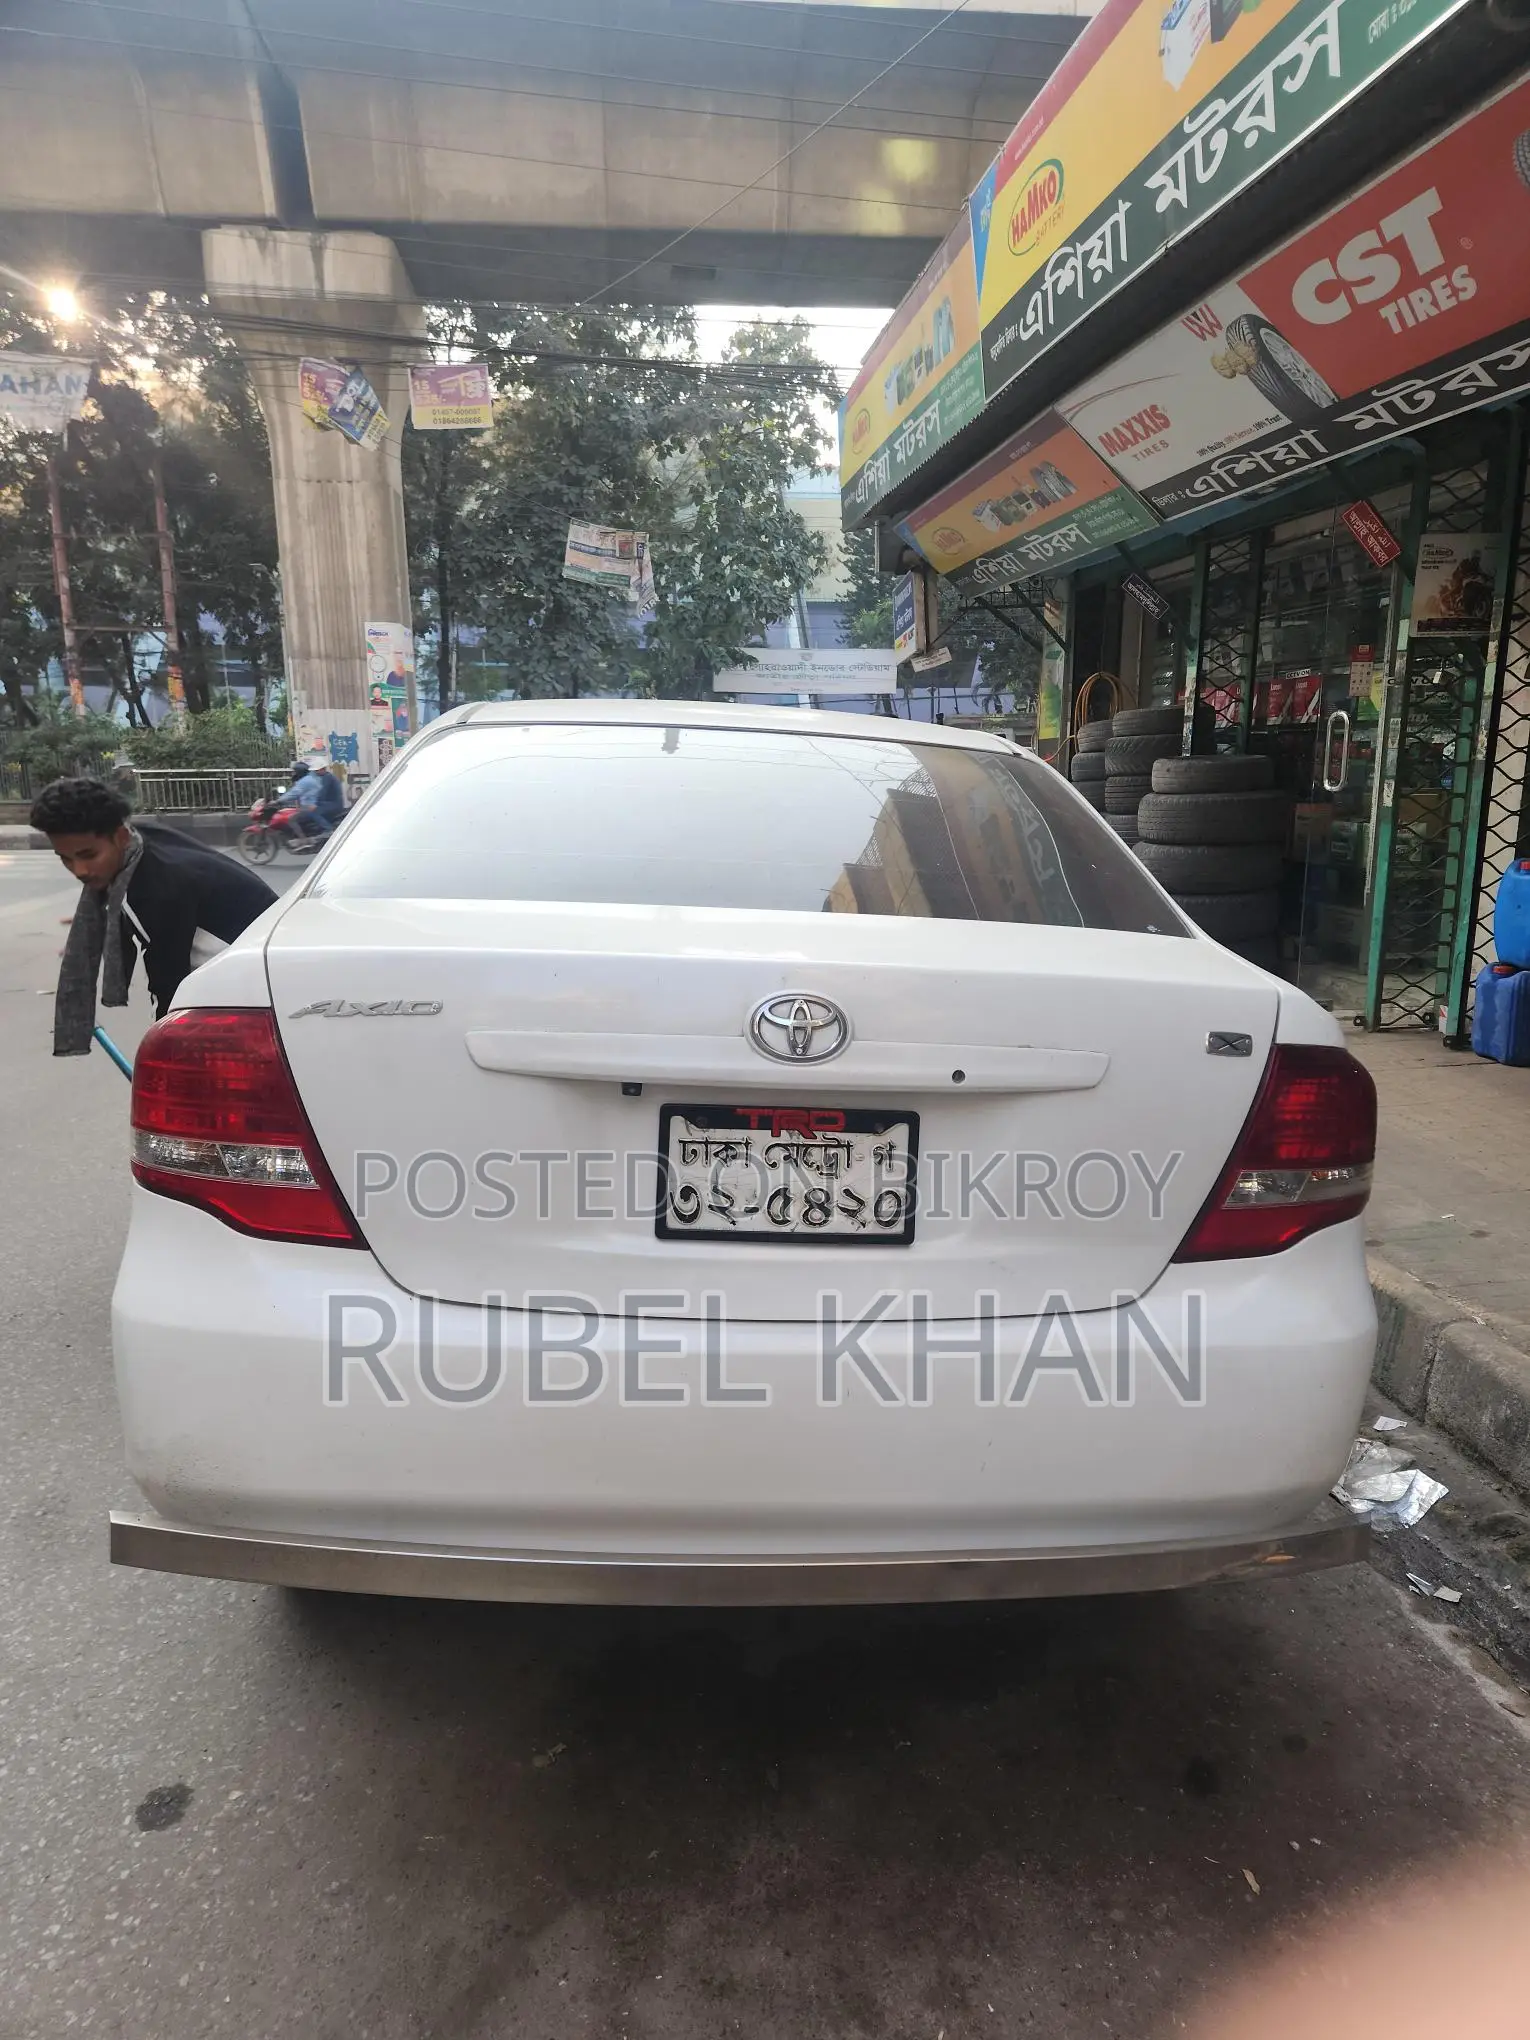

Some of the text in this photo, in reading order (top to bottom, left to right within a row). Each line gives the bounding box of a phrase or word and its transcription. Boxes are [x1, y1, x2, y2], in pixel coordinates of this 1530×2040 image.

[1019, 199, 1132, 341] এশিয়া
[1144, 0, 1342, 213] মটরস
[1012, 169, 1057, 247] HAMKO
[1292, 186, 1446, 325] CST
[1378, 264, 1478, 334] TIRES
[856, 398, 941, 504] এশিয়া মটরস
[1098, 404, 1172, 458] MAXXIS
[1132, 439, 1170, 461] TIRES
[1186, 429, 1329, 498] এশিয়া
[972, 522, 1092, 584] এশিয়া মটরস
[288, 998, 444, 1019] AXIO
[678, 1136, 754, 1168] ঢাকা
[734, 1108, 847, 1140] TRD
